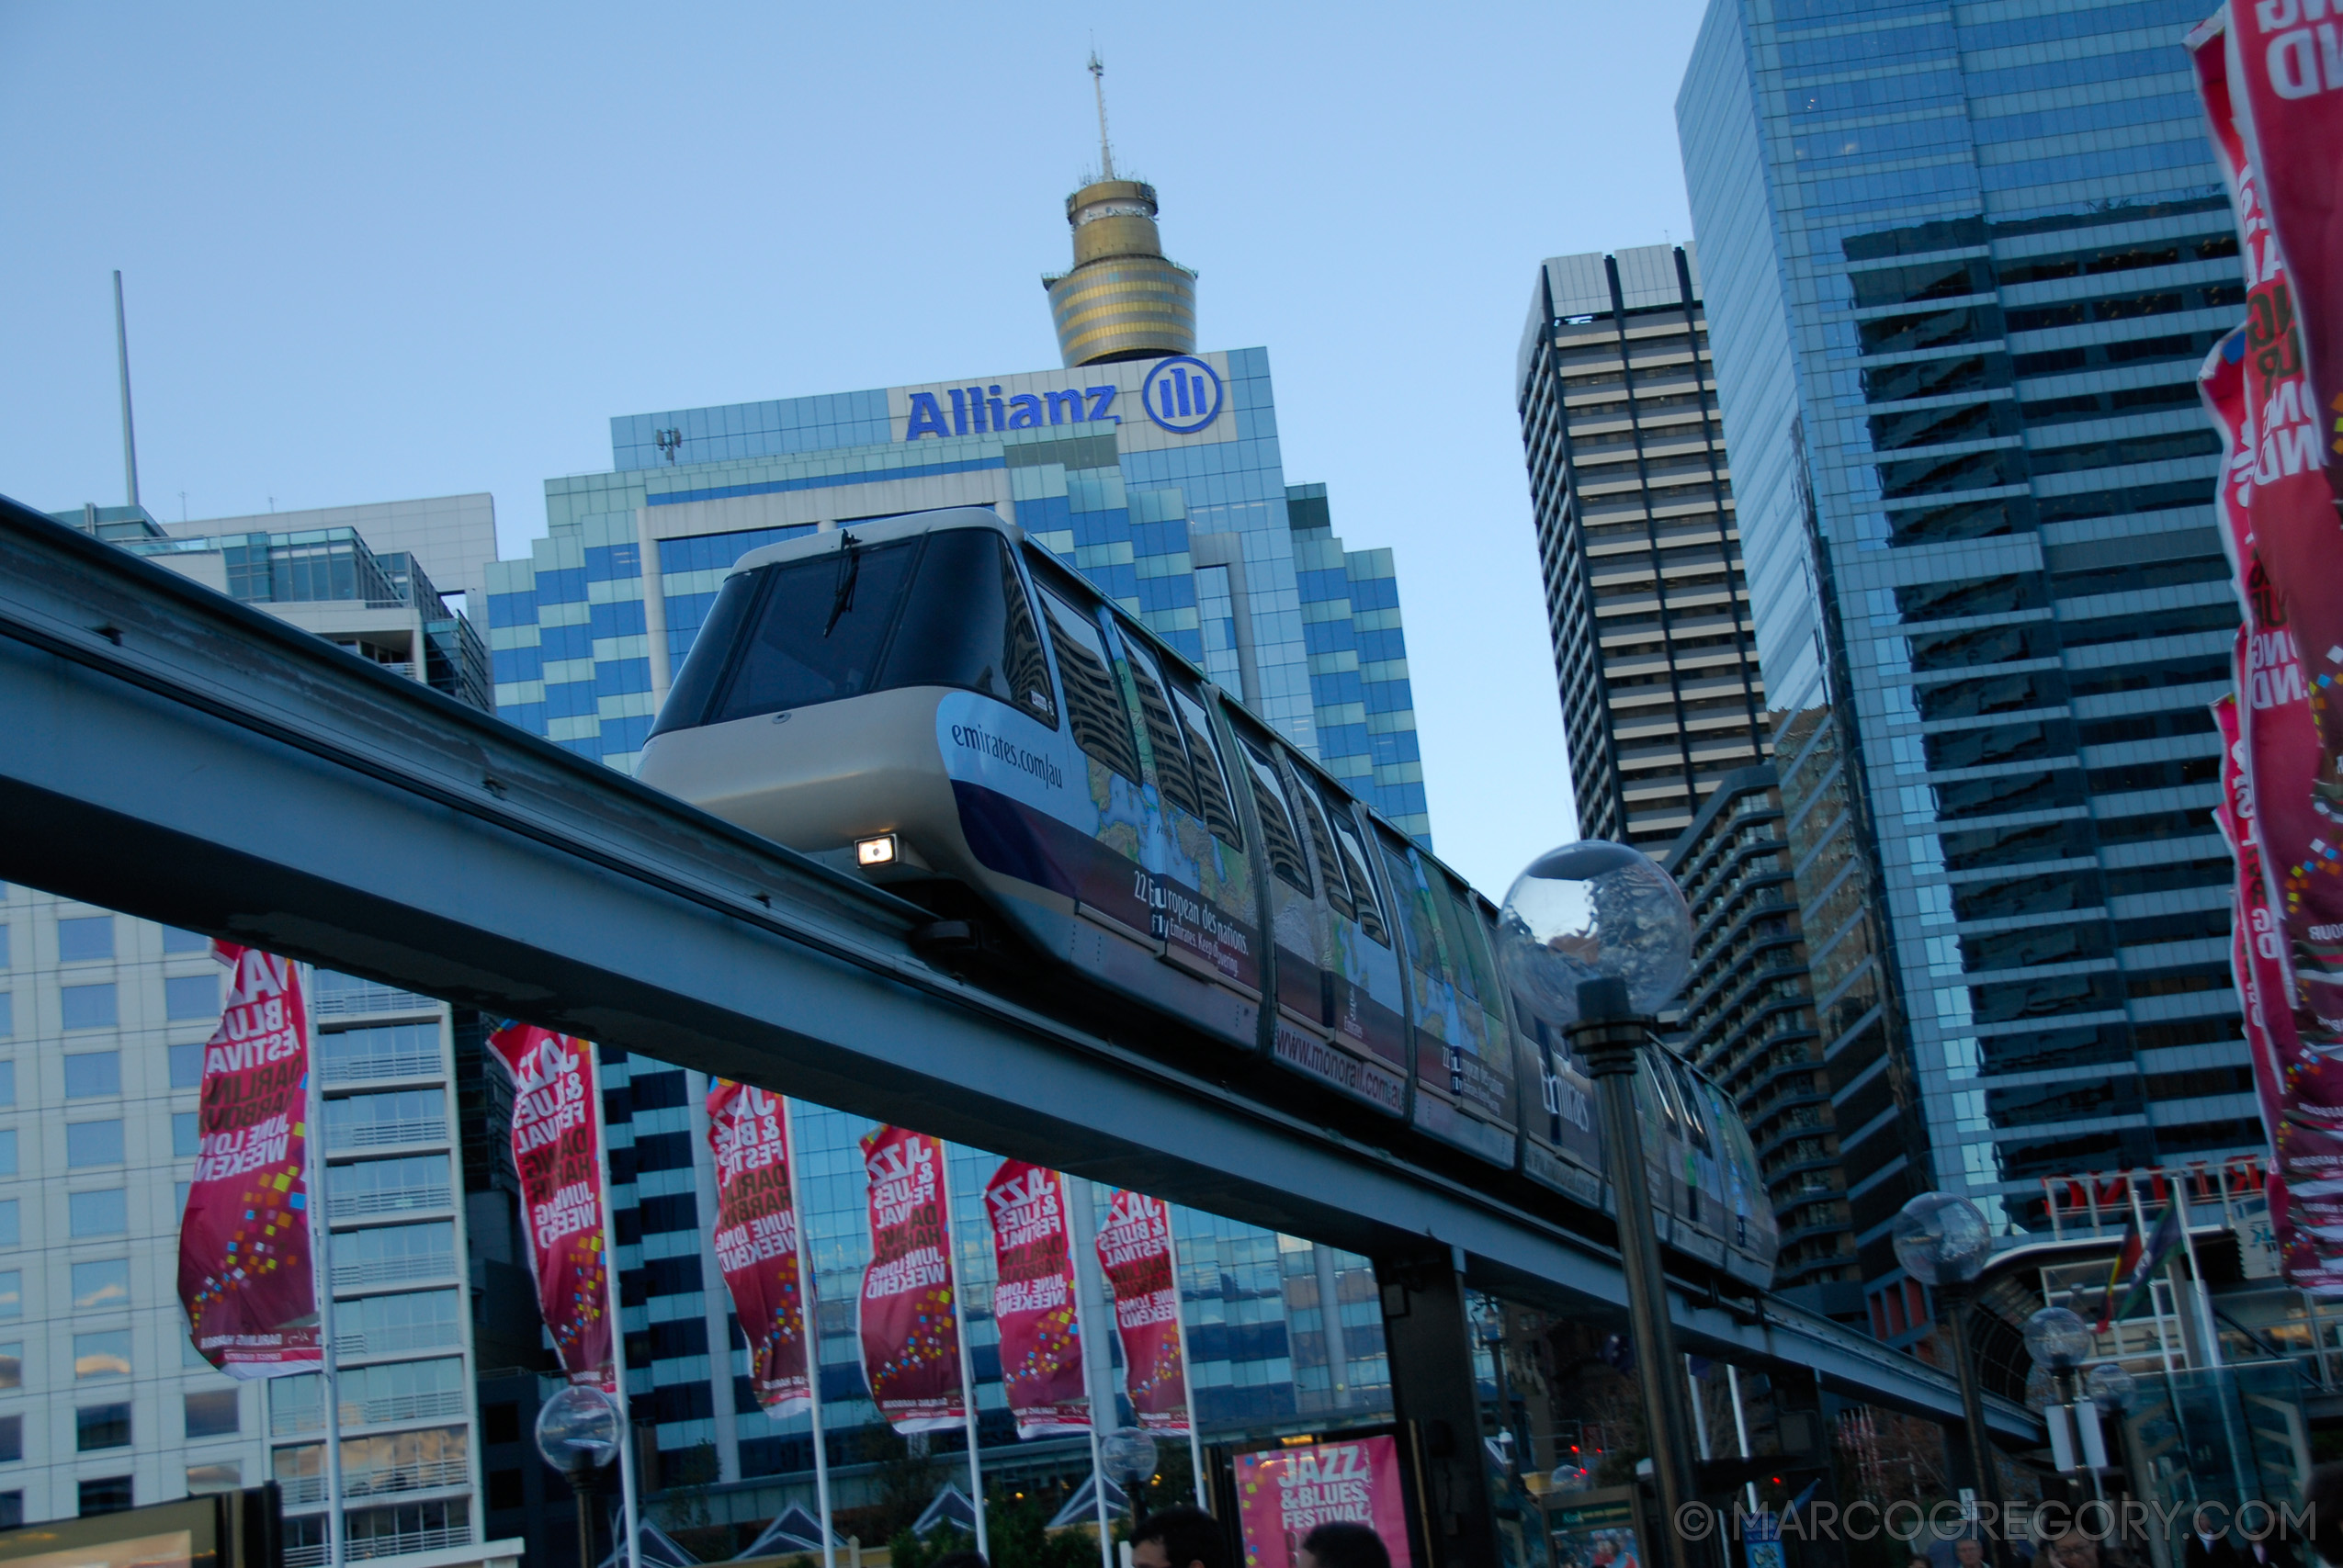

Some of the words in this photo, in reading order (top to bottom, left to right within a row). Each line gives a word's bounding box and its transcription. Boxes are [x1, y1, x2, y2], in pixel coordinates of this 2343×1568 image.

[906, 384, 1121, 441] Allianz
[951, 723, 1063, 790] emirates.com/au
[1149, 877, 1200, 925] European
[1277, 1445, 1367, 1488] JAZZ
[1282, 1505, 1370, 1530] FESTIVAL
